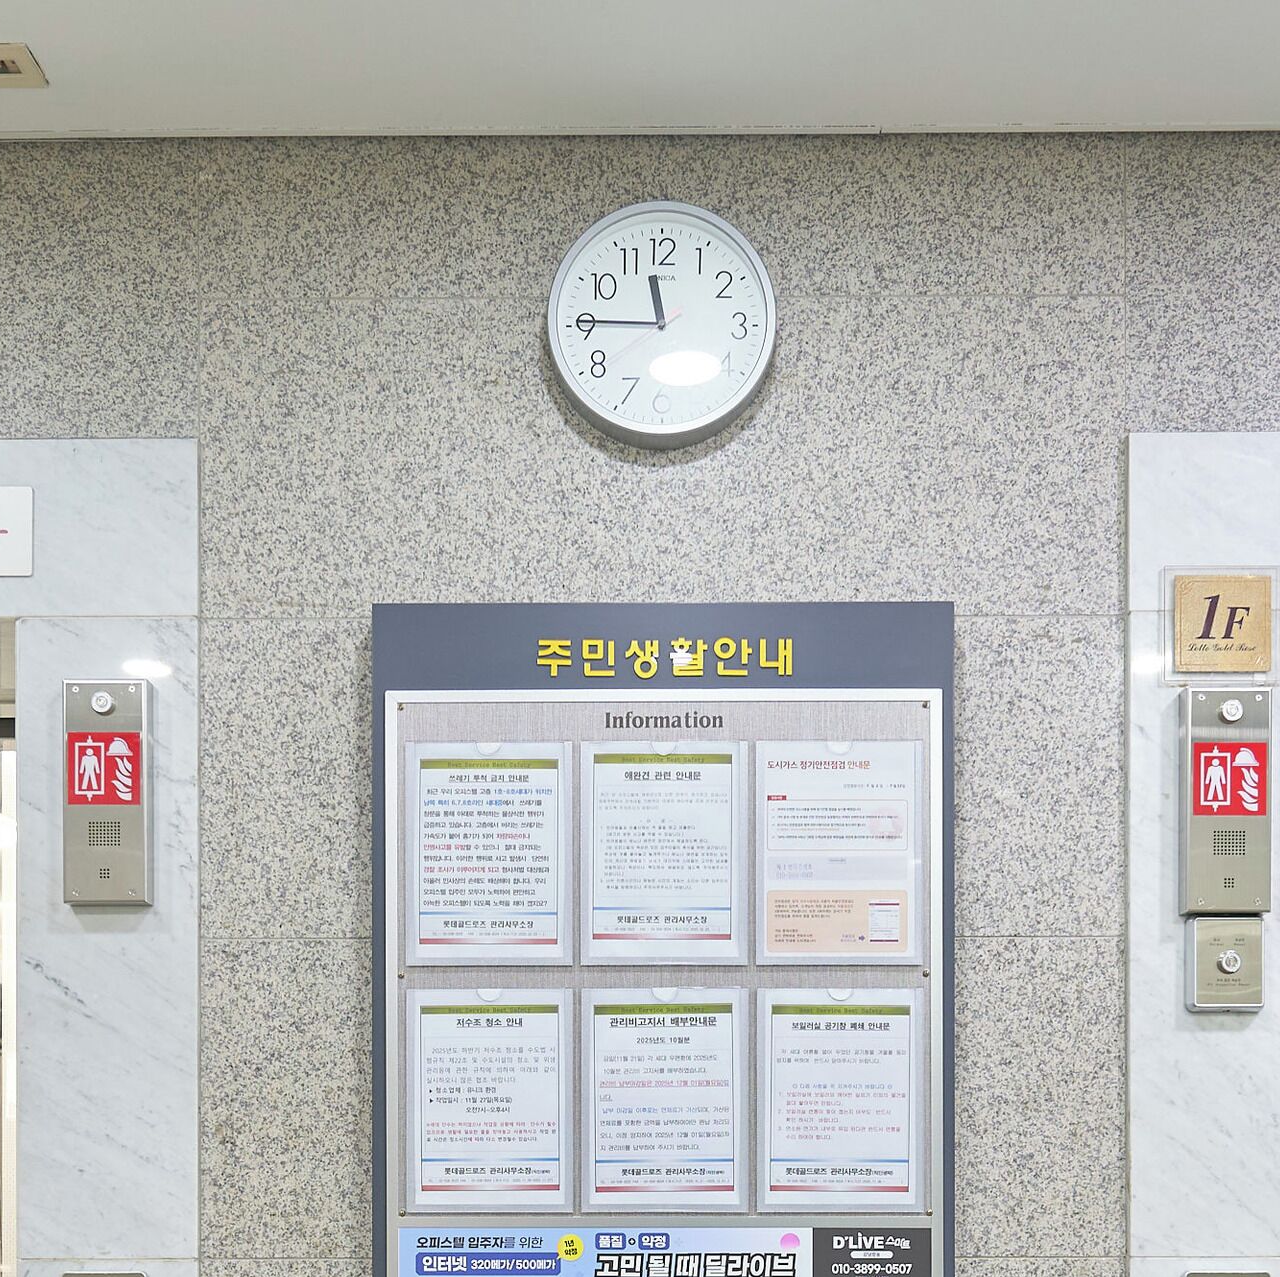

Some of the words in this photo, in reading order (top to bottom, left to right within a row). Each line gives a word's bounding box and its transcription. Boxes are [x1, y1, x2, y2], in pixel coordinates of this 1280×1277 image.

[620, 248, 638, 275] 11
[649, 238, 675, 266] 12
[696, 248, 702, 275] 1
[591, 273, 616, 300] 10
[715, 271, 733, 298] 2
[576, 313, 596, 340] 9
[731, 312, 747, 339] 3
[591, 350, 606, 378] 8
[721, 352, 735, 377] 4
[622, 377, 640, 405] 7
[653, 386, 670, 414] 6
[1195, 594, 1250, 640] 1F
[537, 637, 793, 679] 주민생활안내
[605, 711, 723, 728] Information
[676, 770, 701, 780] 안내문
[767, 761, 798, 770] 도시가스
[847, 761, 871, 770] 안내문
[456, 1018, 481, 1027] 저수조
[486, 1018, 502, 1027] 청소
[506, 1018, 523, 1027] 안내
[609, 1017, 665, 1027] 관리비고지서
[670, 1017, 717, 1027] 배부안내문
[792, 1022, 821, 1031] 보일러실
[868, 1022, 891, 1031] 안내문
[444, 1167, 486, 1175] 롯데골드로즈
[621, 1168, 662, 1176] 롯데골드로즈
[785, 1168, 828, 1176] 롯데골드로즈
[417, 1237, 465, 1248] 오피스텔
[468, 1236, 516, 1248] 입주자를
[519, 1237, 543, 1248] 위한
[598, 1236, 623, 1249] 품질
[642, 1236, 667, 1249] 약정
[422, 1256, 467, 1273] 인터넷
[471, 1259, 556, 1271] 320메가/500메가
[832, 1264, 912, 1274] 010-3899-0507
